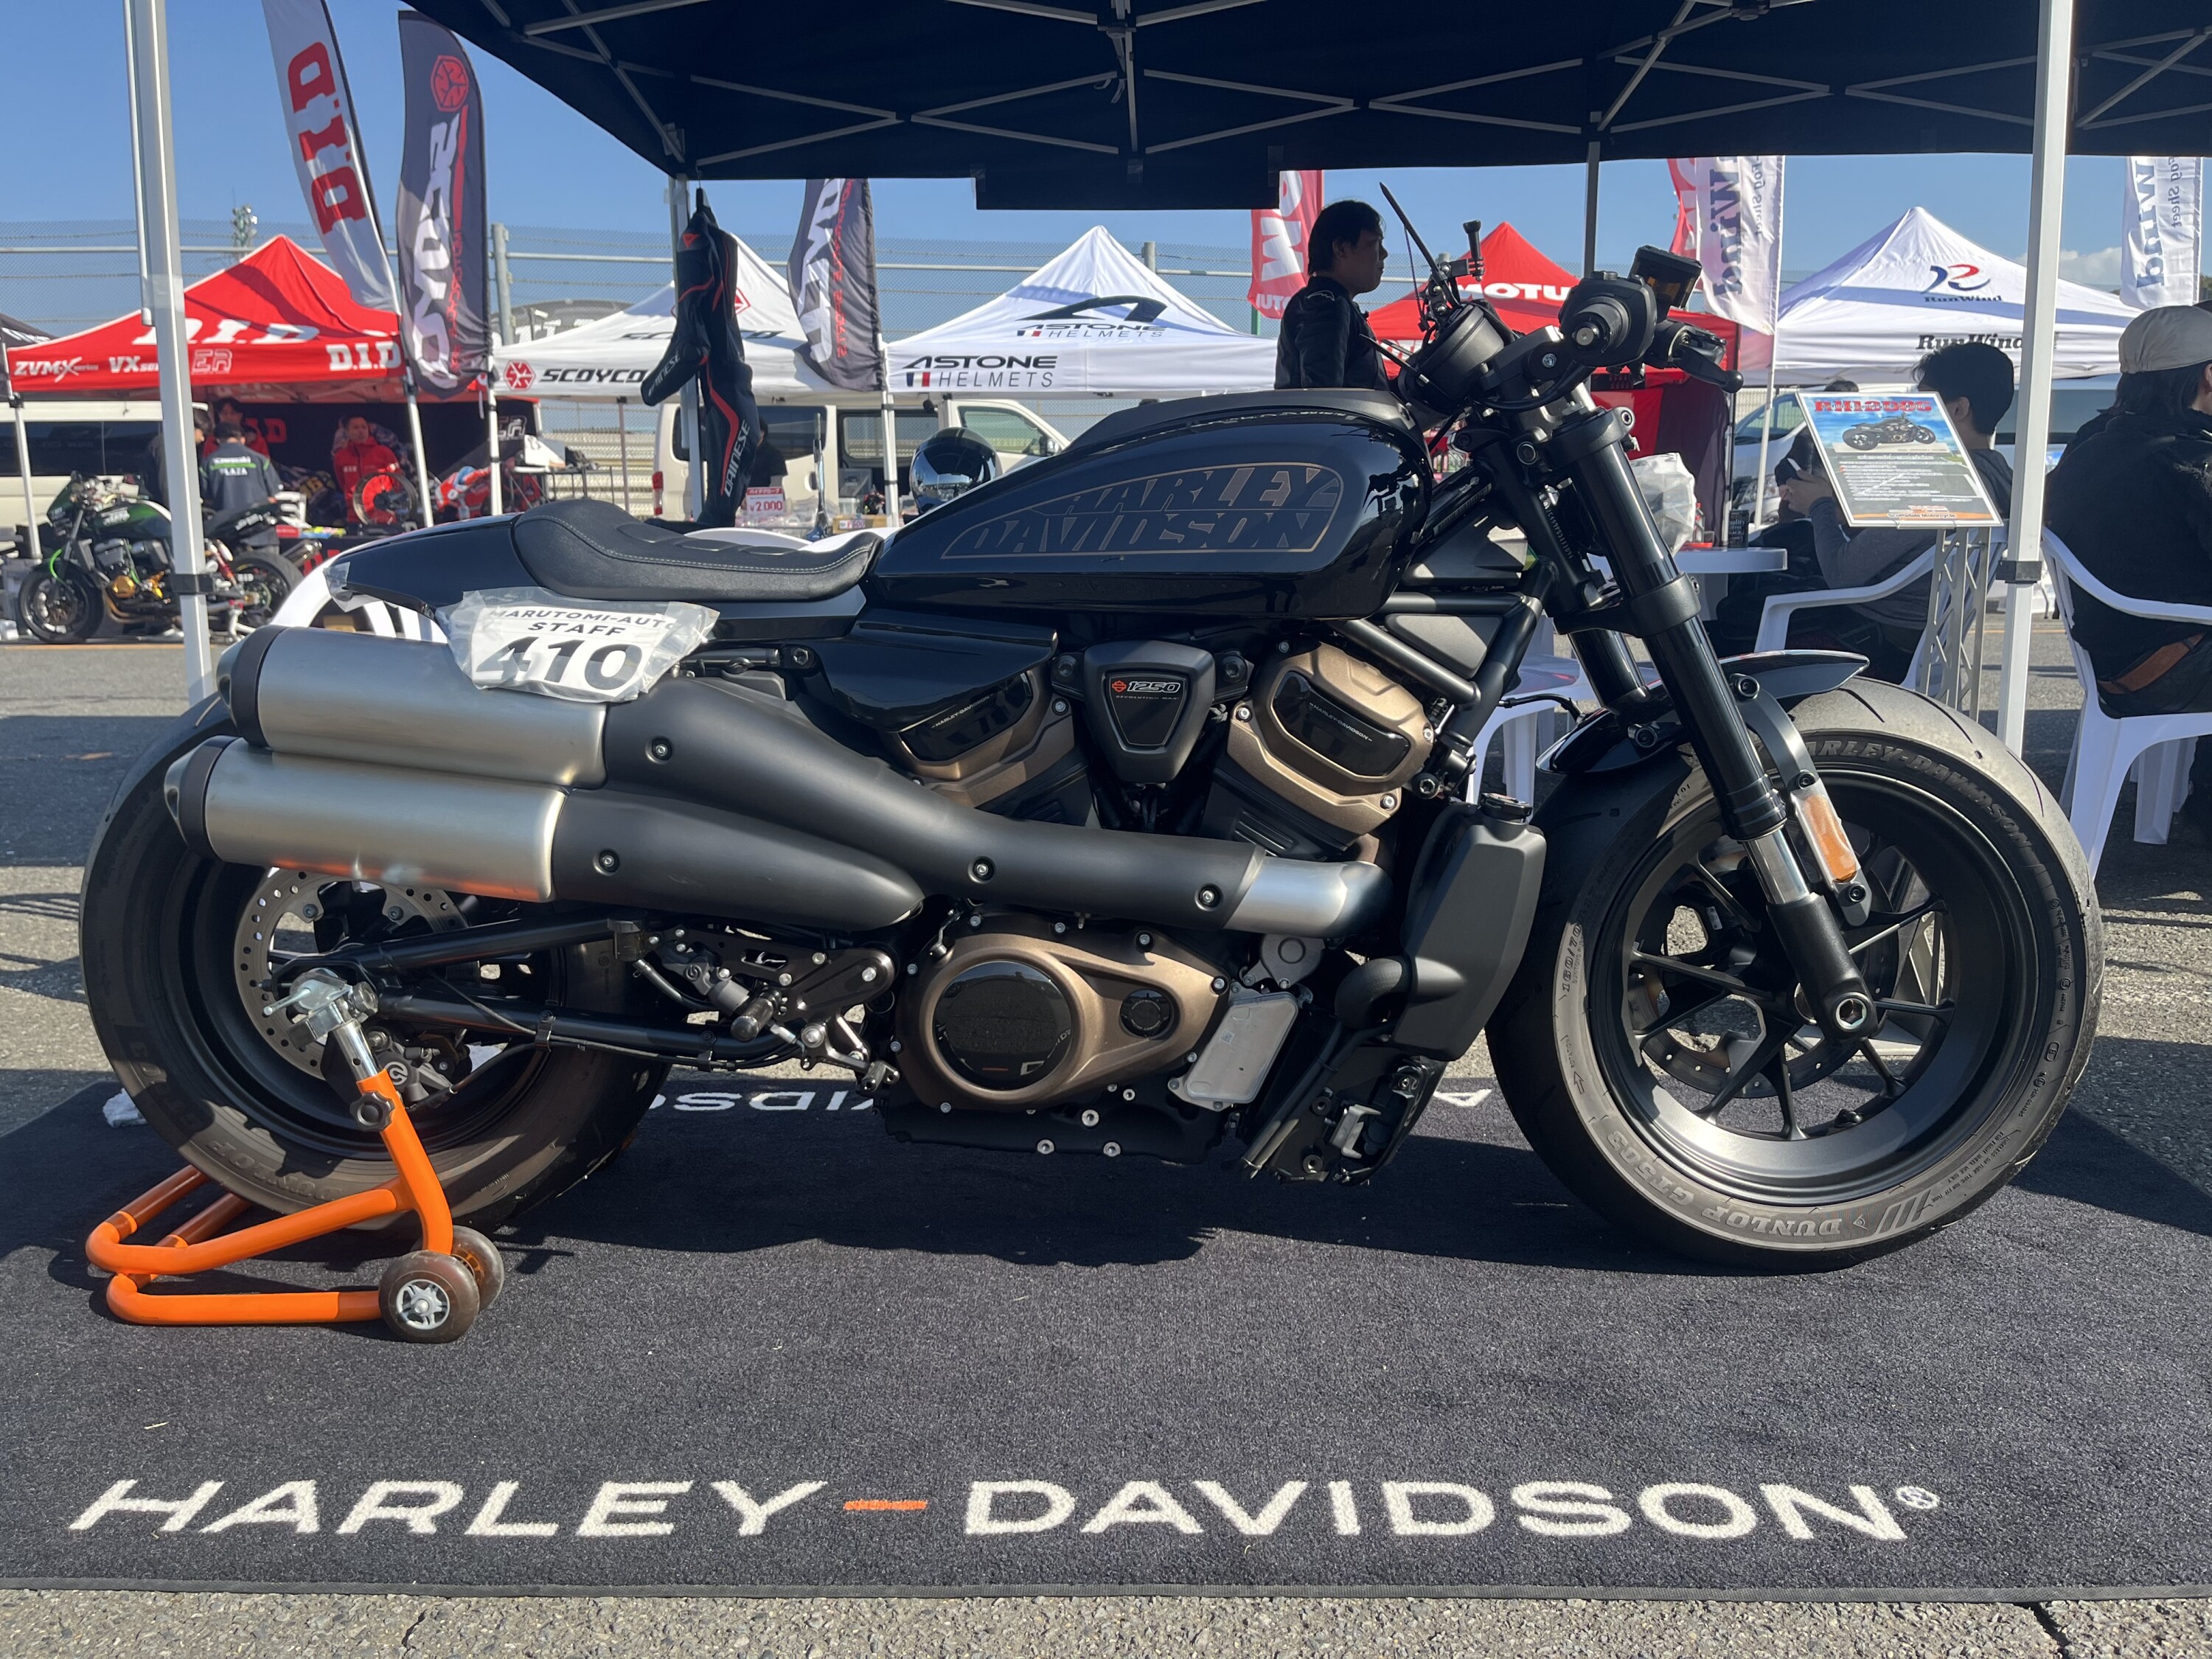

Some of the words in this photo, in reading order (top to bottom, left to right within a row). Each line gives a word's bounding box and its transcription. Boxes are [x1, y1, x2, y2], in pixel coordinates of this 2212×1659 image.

[1457, 282, 1571, 301] MOTU
[1020, 323, 1167, 332] ASTONE
[326, 341, 402, 371] D.I.D
[902, 355, 1058, 369] ASTONE
[539, 369, 650, 383] SCOYCO
[939, 372, 1054, 388] HELMETS
[723, 419, 751, 498] DAINESE
[528, 621, 626, 636] STAFF
[476, 636, 643, 691] 410
[1127, 681, 1181, 693] 1250
[1805, 740, 2034, 848] ARLEY-DAVIDSON
[1606, 1130, 1695, 1207] GT503
[1701, 1204, 1843, 1237] DUNLOP
